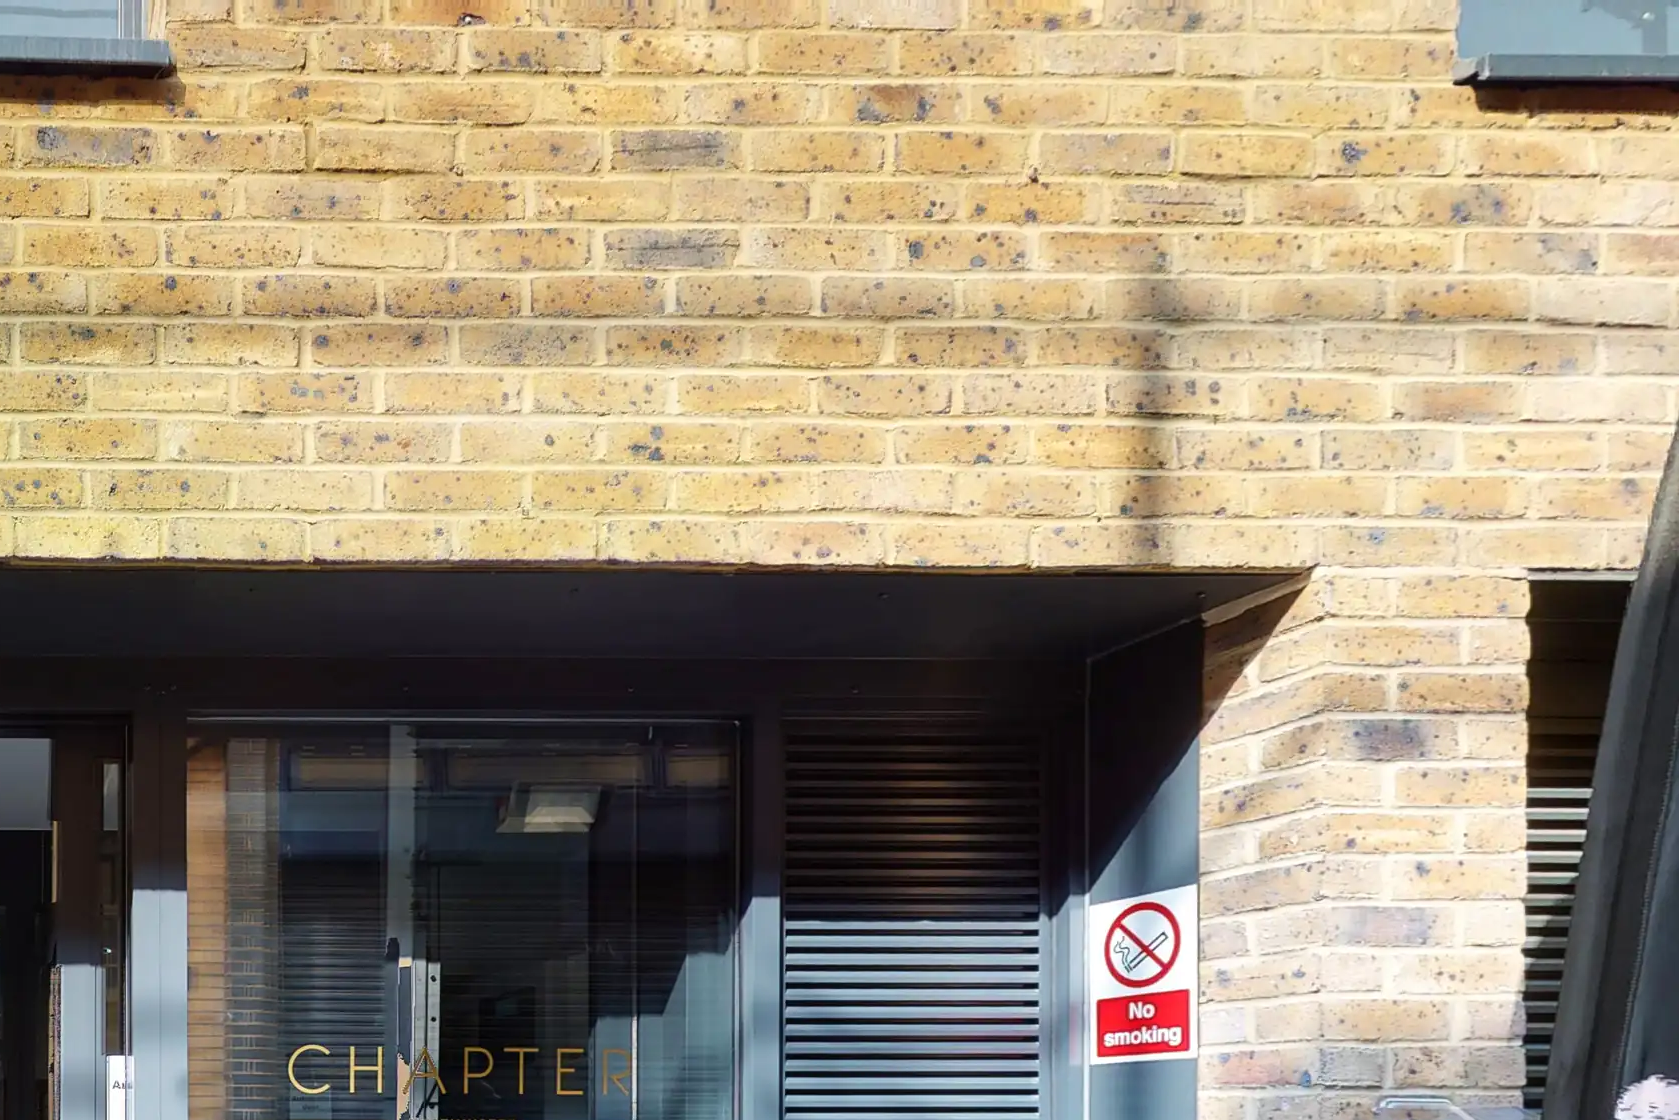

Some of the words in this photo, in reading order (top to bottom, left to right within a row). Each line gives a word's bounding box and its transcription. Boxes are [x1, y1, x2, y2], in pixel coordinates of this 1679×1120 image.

[1128, 1000, 1156, 1020] No
[1103, 1025, 1183, 1048] smoking
[287, 1043, 632, 1096] CHAPTER
